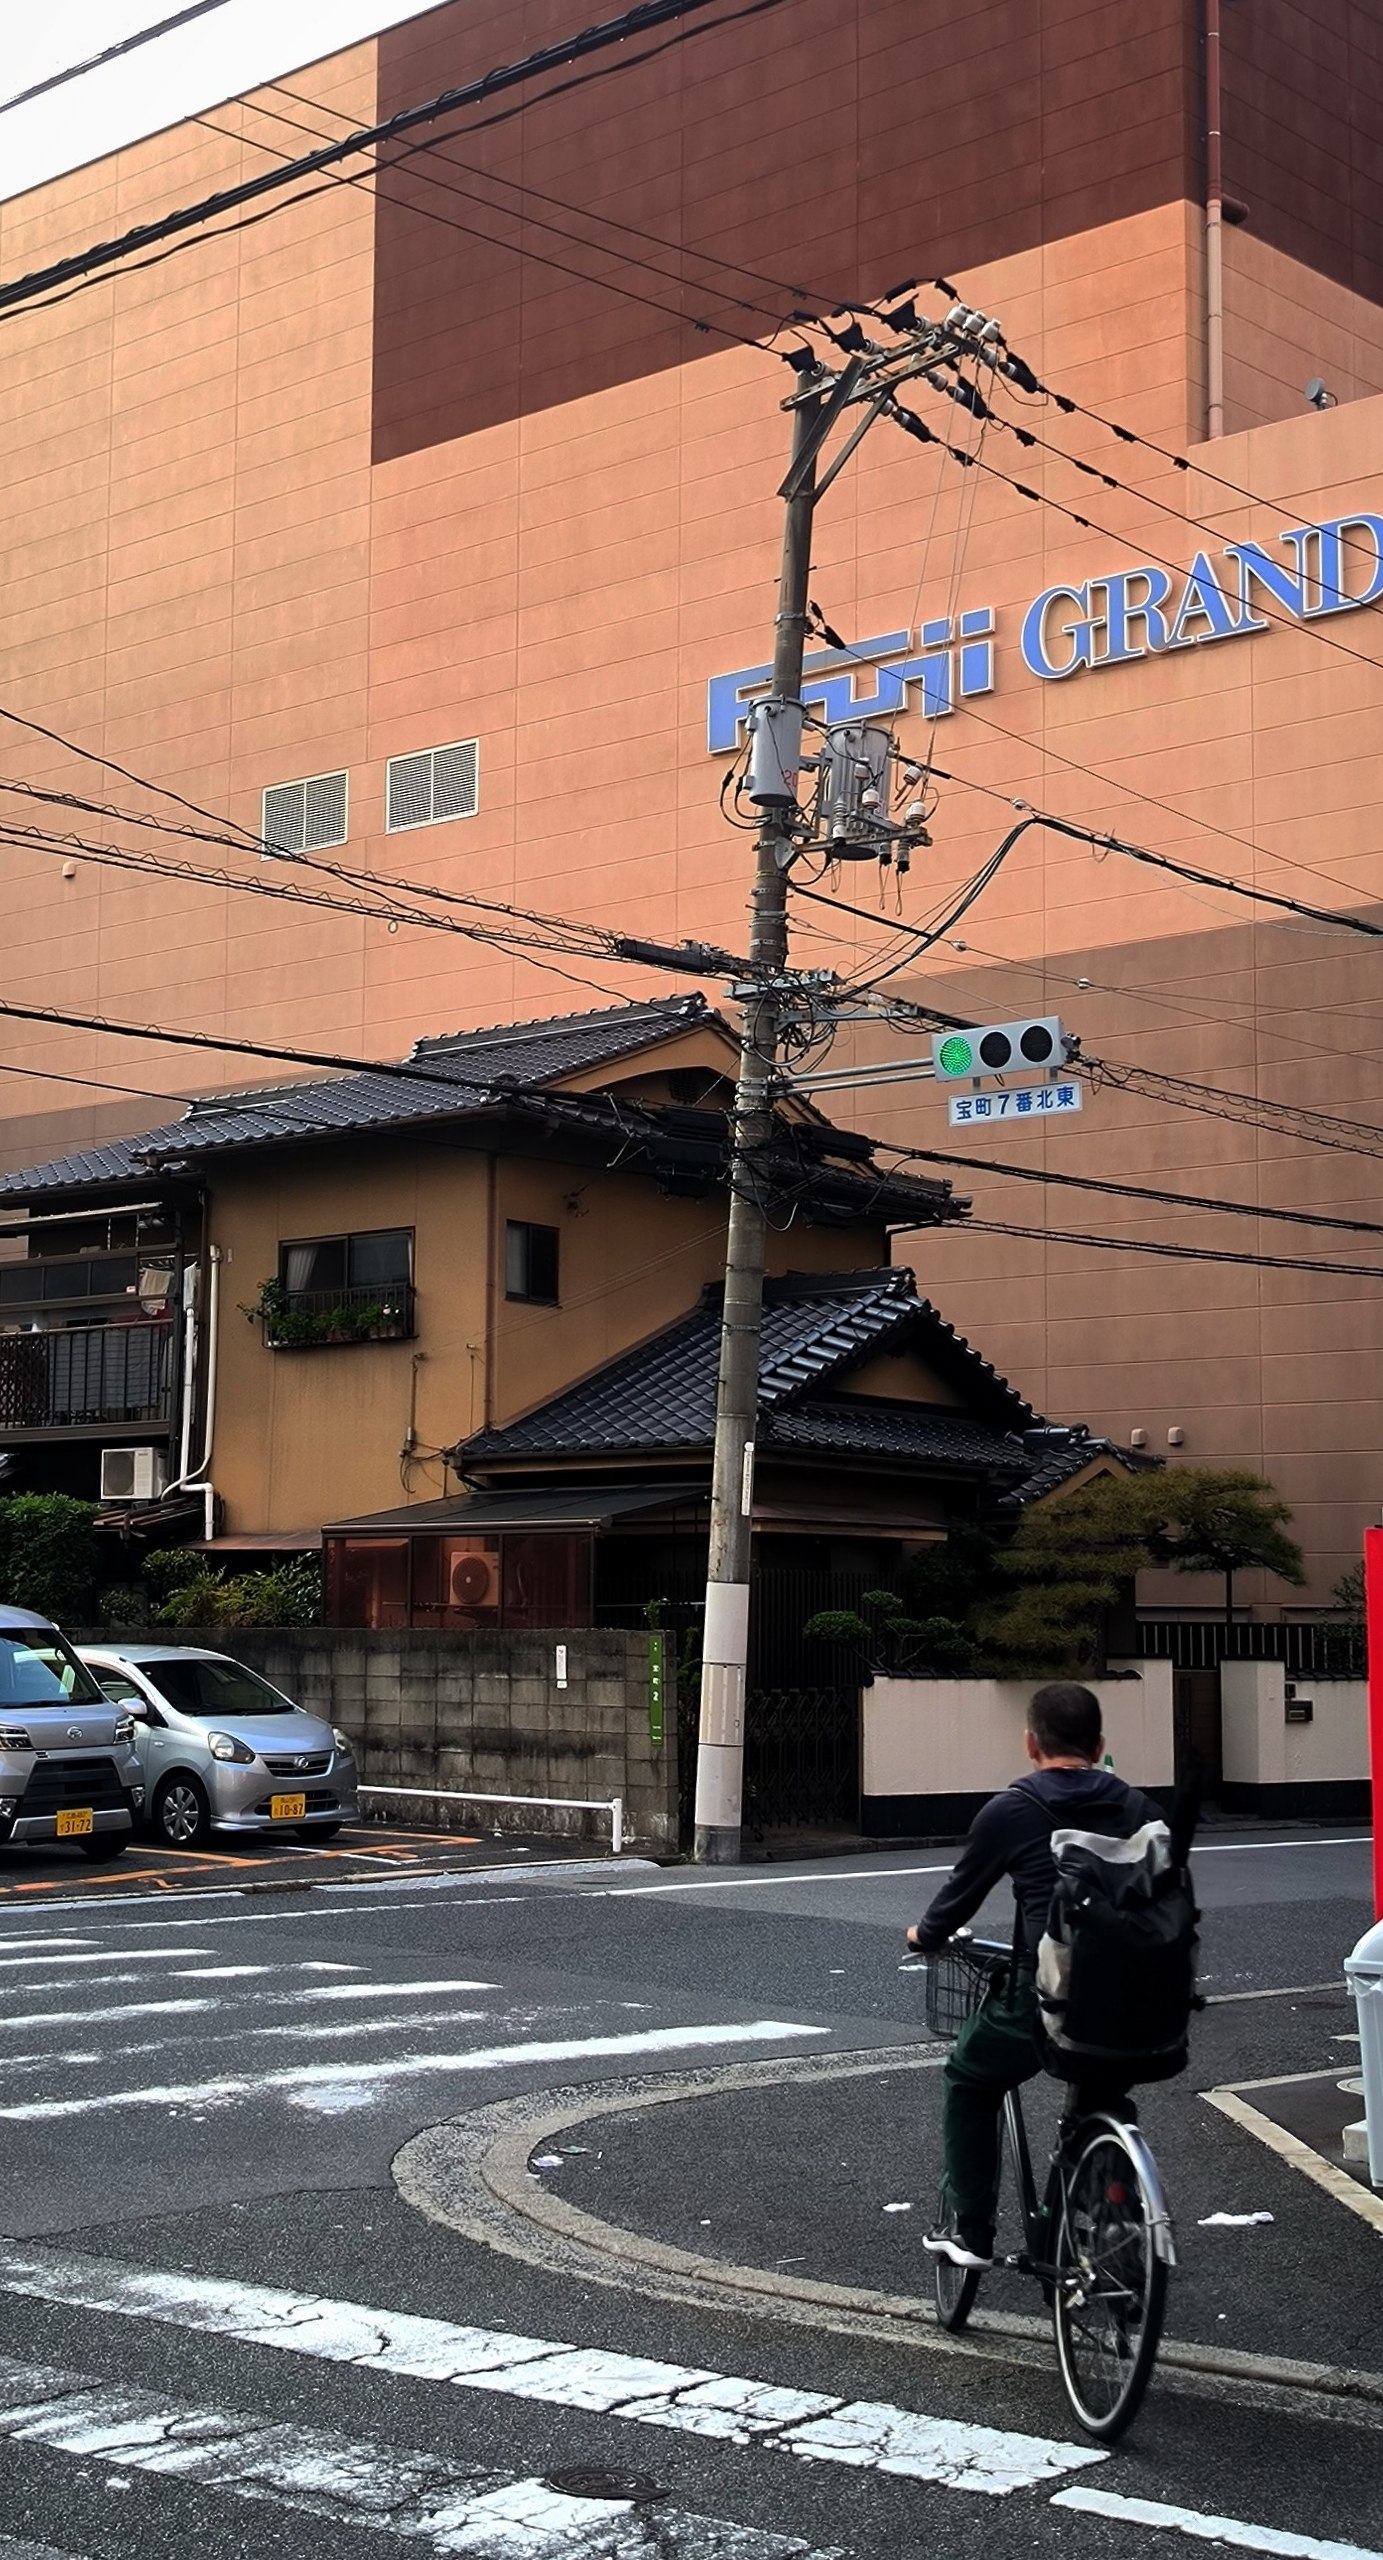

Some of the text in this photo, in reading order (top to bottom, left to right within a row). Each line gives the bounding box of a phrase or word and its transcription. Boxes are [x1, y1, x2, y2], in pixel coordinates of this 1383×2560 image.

[1020, 513, 1383, 679] GRAND
[956, 1086, 1075, 1120] 宝町7番北東
[65, 1819, 91, 1833] 31-72
